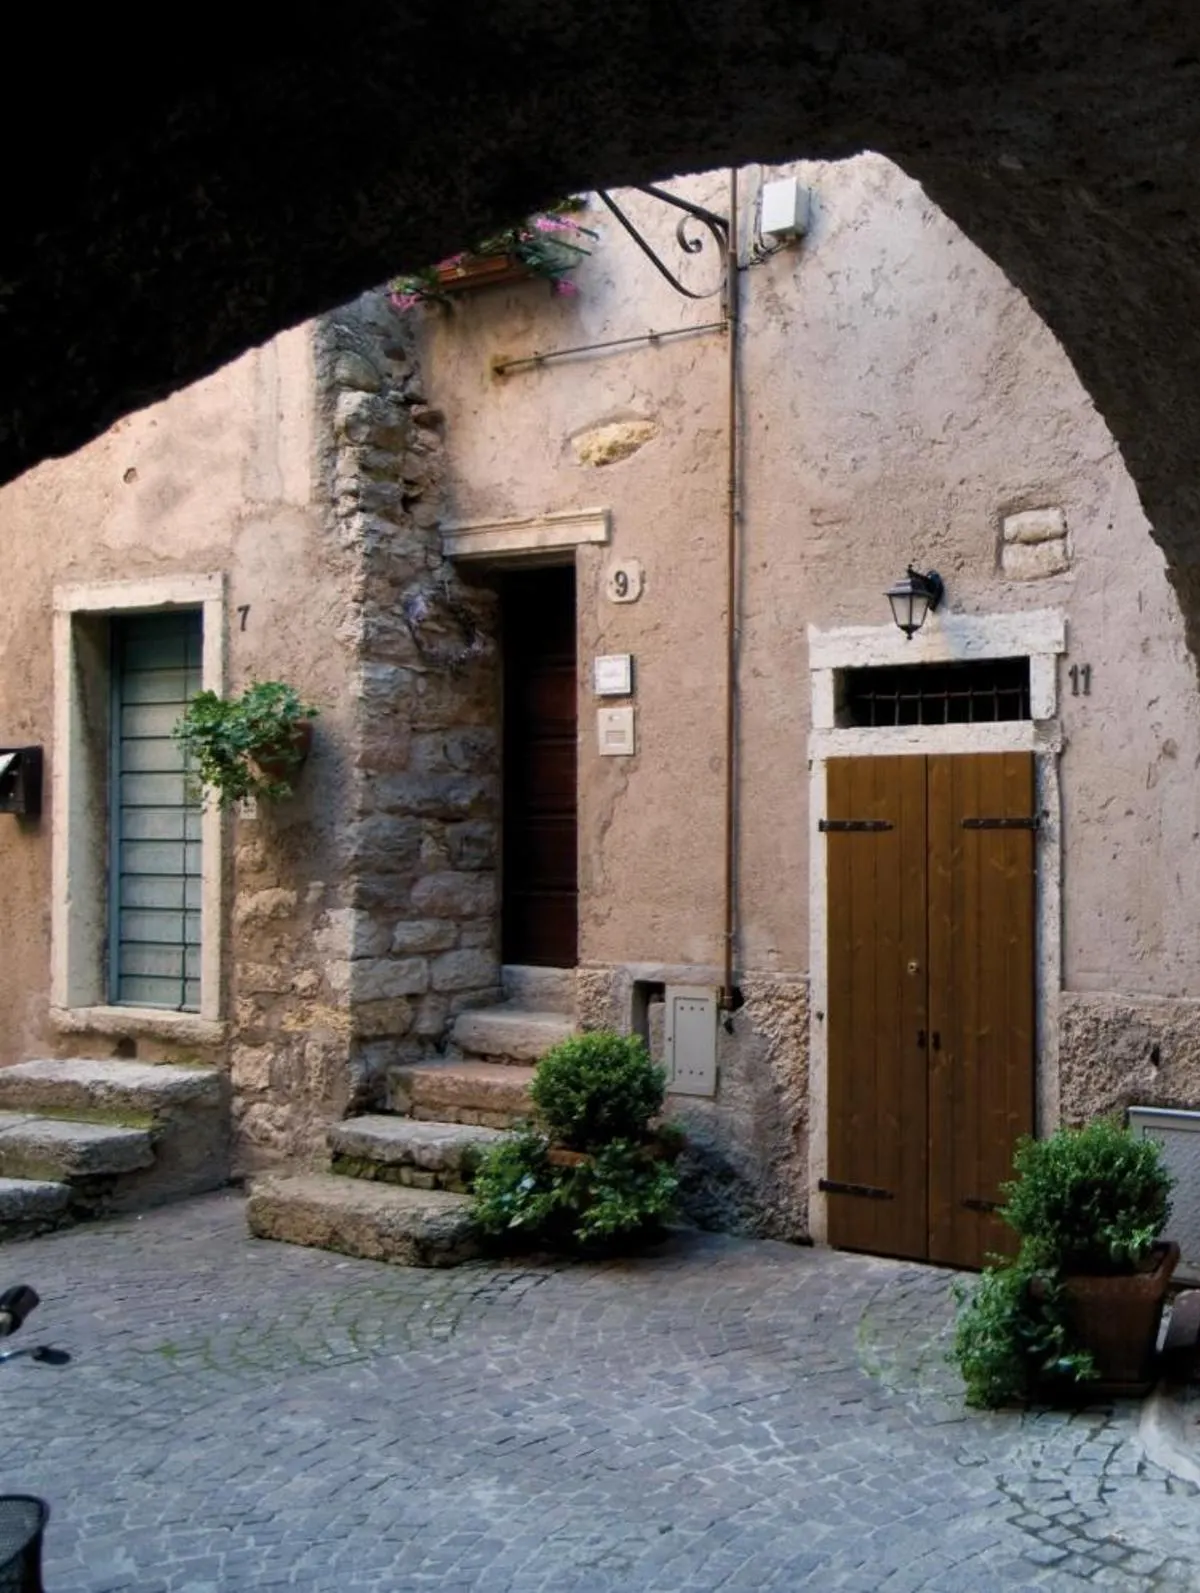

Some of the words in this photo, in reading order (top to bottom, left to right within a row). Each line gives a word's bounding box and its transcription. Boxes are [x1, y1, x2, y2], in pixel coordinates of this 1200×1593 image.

[614, 570, 628, 598] 9
[237, 604, 251, 632] 7
[1068, 663, 1092, 697] 11
